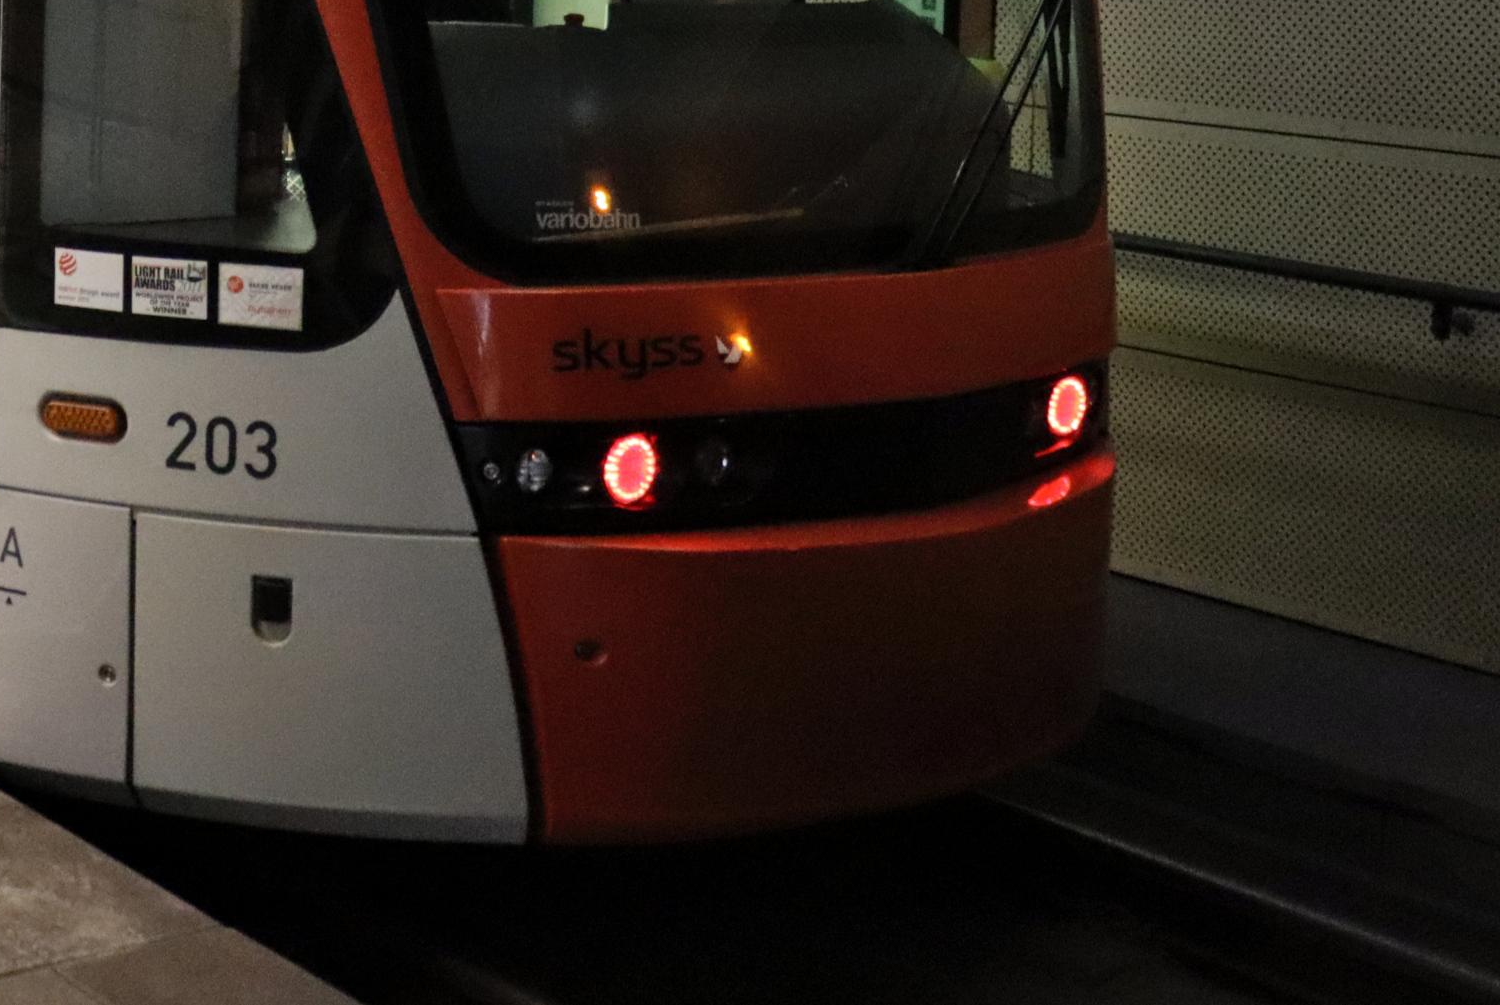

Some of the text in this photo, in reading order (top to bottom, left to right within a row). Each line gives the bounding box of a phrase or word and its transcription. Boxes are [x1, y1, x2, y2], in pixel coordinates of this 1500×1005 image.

[535, 206, 641, 230] variobahn
[134, 265, 185, 280] LIGHT RAIL
[134, 277, 176, 292] AWARDS
[152, 306, 187, 315] WINNER
[551, 327, 705, 379] skyss
[164, 411, 279, 480] 203
[0, 526, 24, 569] A
